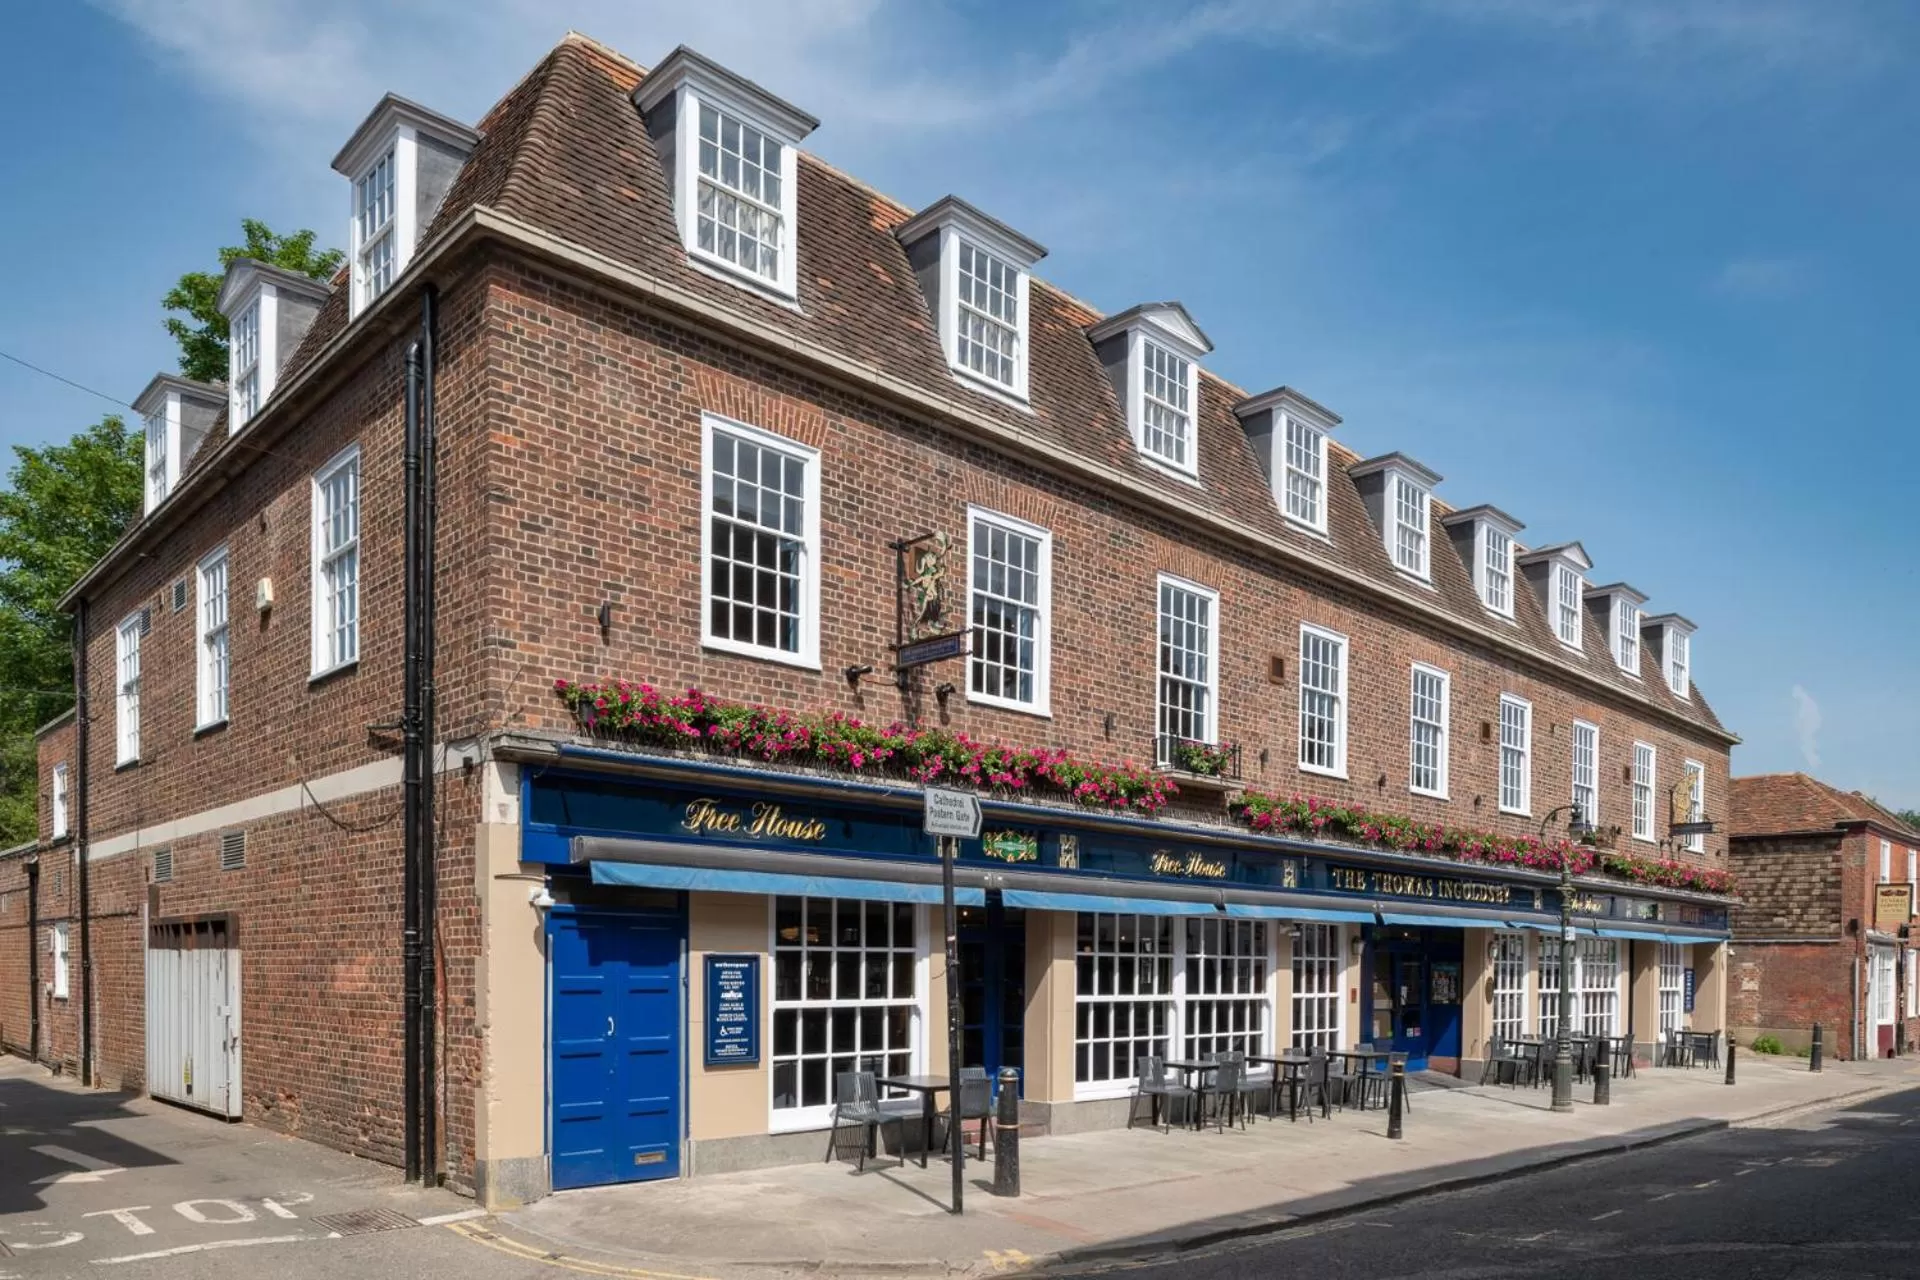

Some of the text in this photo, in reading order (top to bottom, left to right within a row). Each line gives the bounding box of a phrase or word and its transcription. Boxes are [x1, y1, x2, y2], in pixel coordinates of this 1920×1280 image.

[681, 798, 826, 839] Free House
[1150, 850, 1226, 877] Free House
[1333, 868, 1366, 890] THE
[1371, 872, 1433, 897] THOMAS
